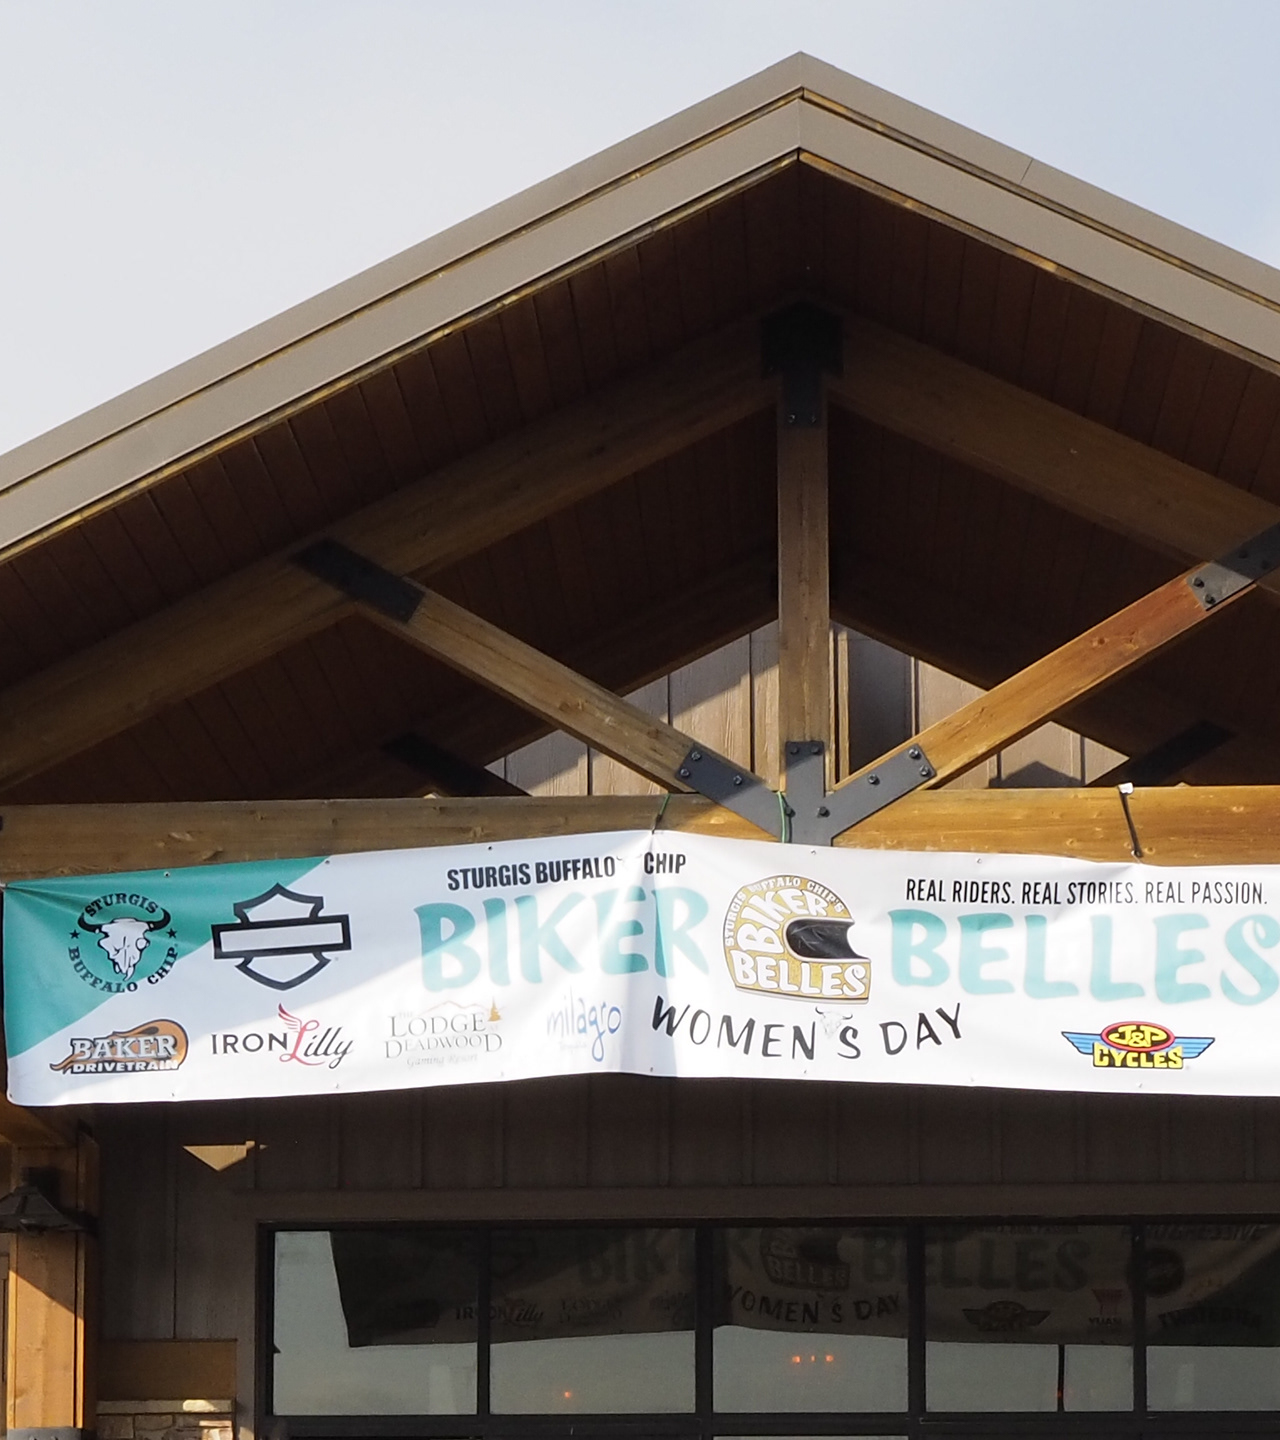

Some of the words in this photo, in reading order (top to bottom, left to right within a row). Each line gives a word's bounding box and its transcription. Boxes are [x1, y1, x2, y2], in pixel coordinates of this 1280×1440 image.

[447, 863, 532, 892] STURGIS
[535, 856, 617, 884] BUFFALO
[643, 852, 687, 876] CHIP
[85, 893, 158, 917] STURGIS
[906, 878, 947, 902] REAL
[953, 880, 1016, 904] RIDERS.
[1021, 881, 1064, 904] REAL
[1067, 881, 1136, 904] STORIES.
[1145, 881, 1187, 904] REAL
[1191, 881, 1268, 905] PASSION.
[736, 888, 828, 954] BIKER
[415, 884, 709, 993] BIKER
[68, 946, 138, 993] BUFFALO
[147, 946, 178, 985] CHIP
[730, 950, 867, 996] BELLES
[389, 1012, 487, 1038] LODGE
[546, 988, 622, 1063] milagro
[885, 1002, 964, 1050] DAY
[1107, 1025, 1167, 1047] J&P
[72, 1034, 178, 1061] BAKER
[211, 1032, 288, 1055] IRON
[384, 1032, 503, 1060] DEADWOOD
[1094, 1042, 1183, 1069] CYCLES
[73, 1060, 179, 1074] DRIVETRAIN
